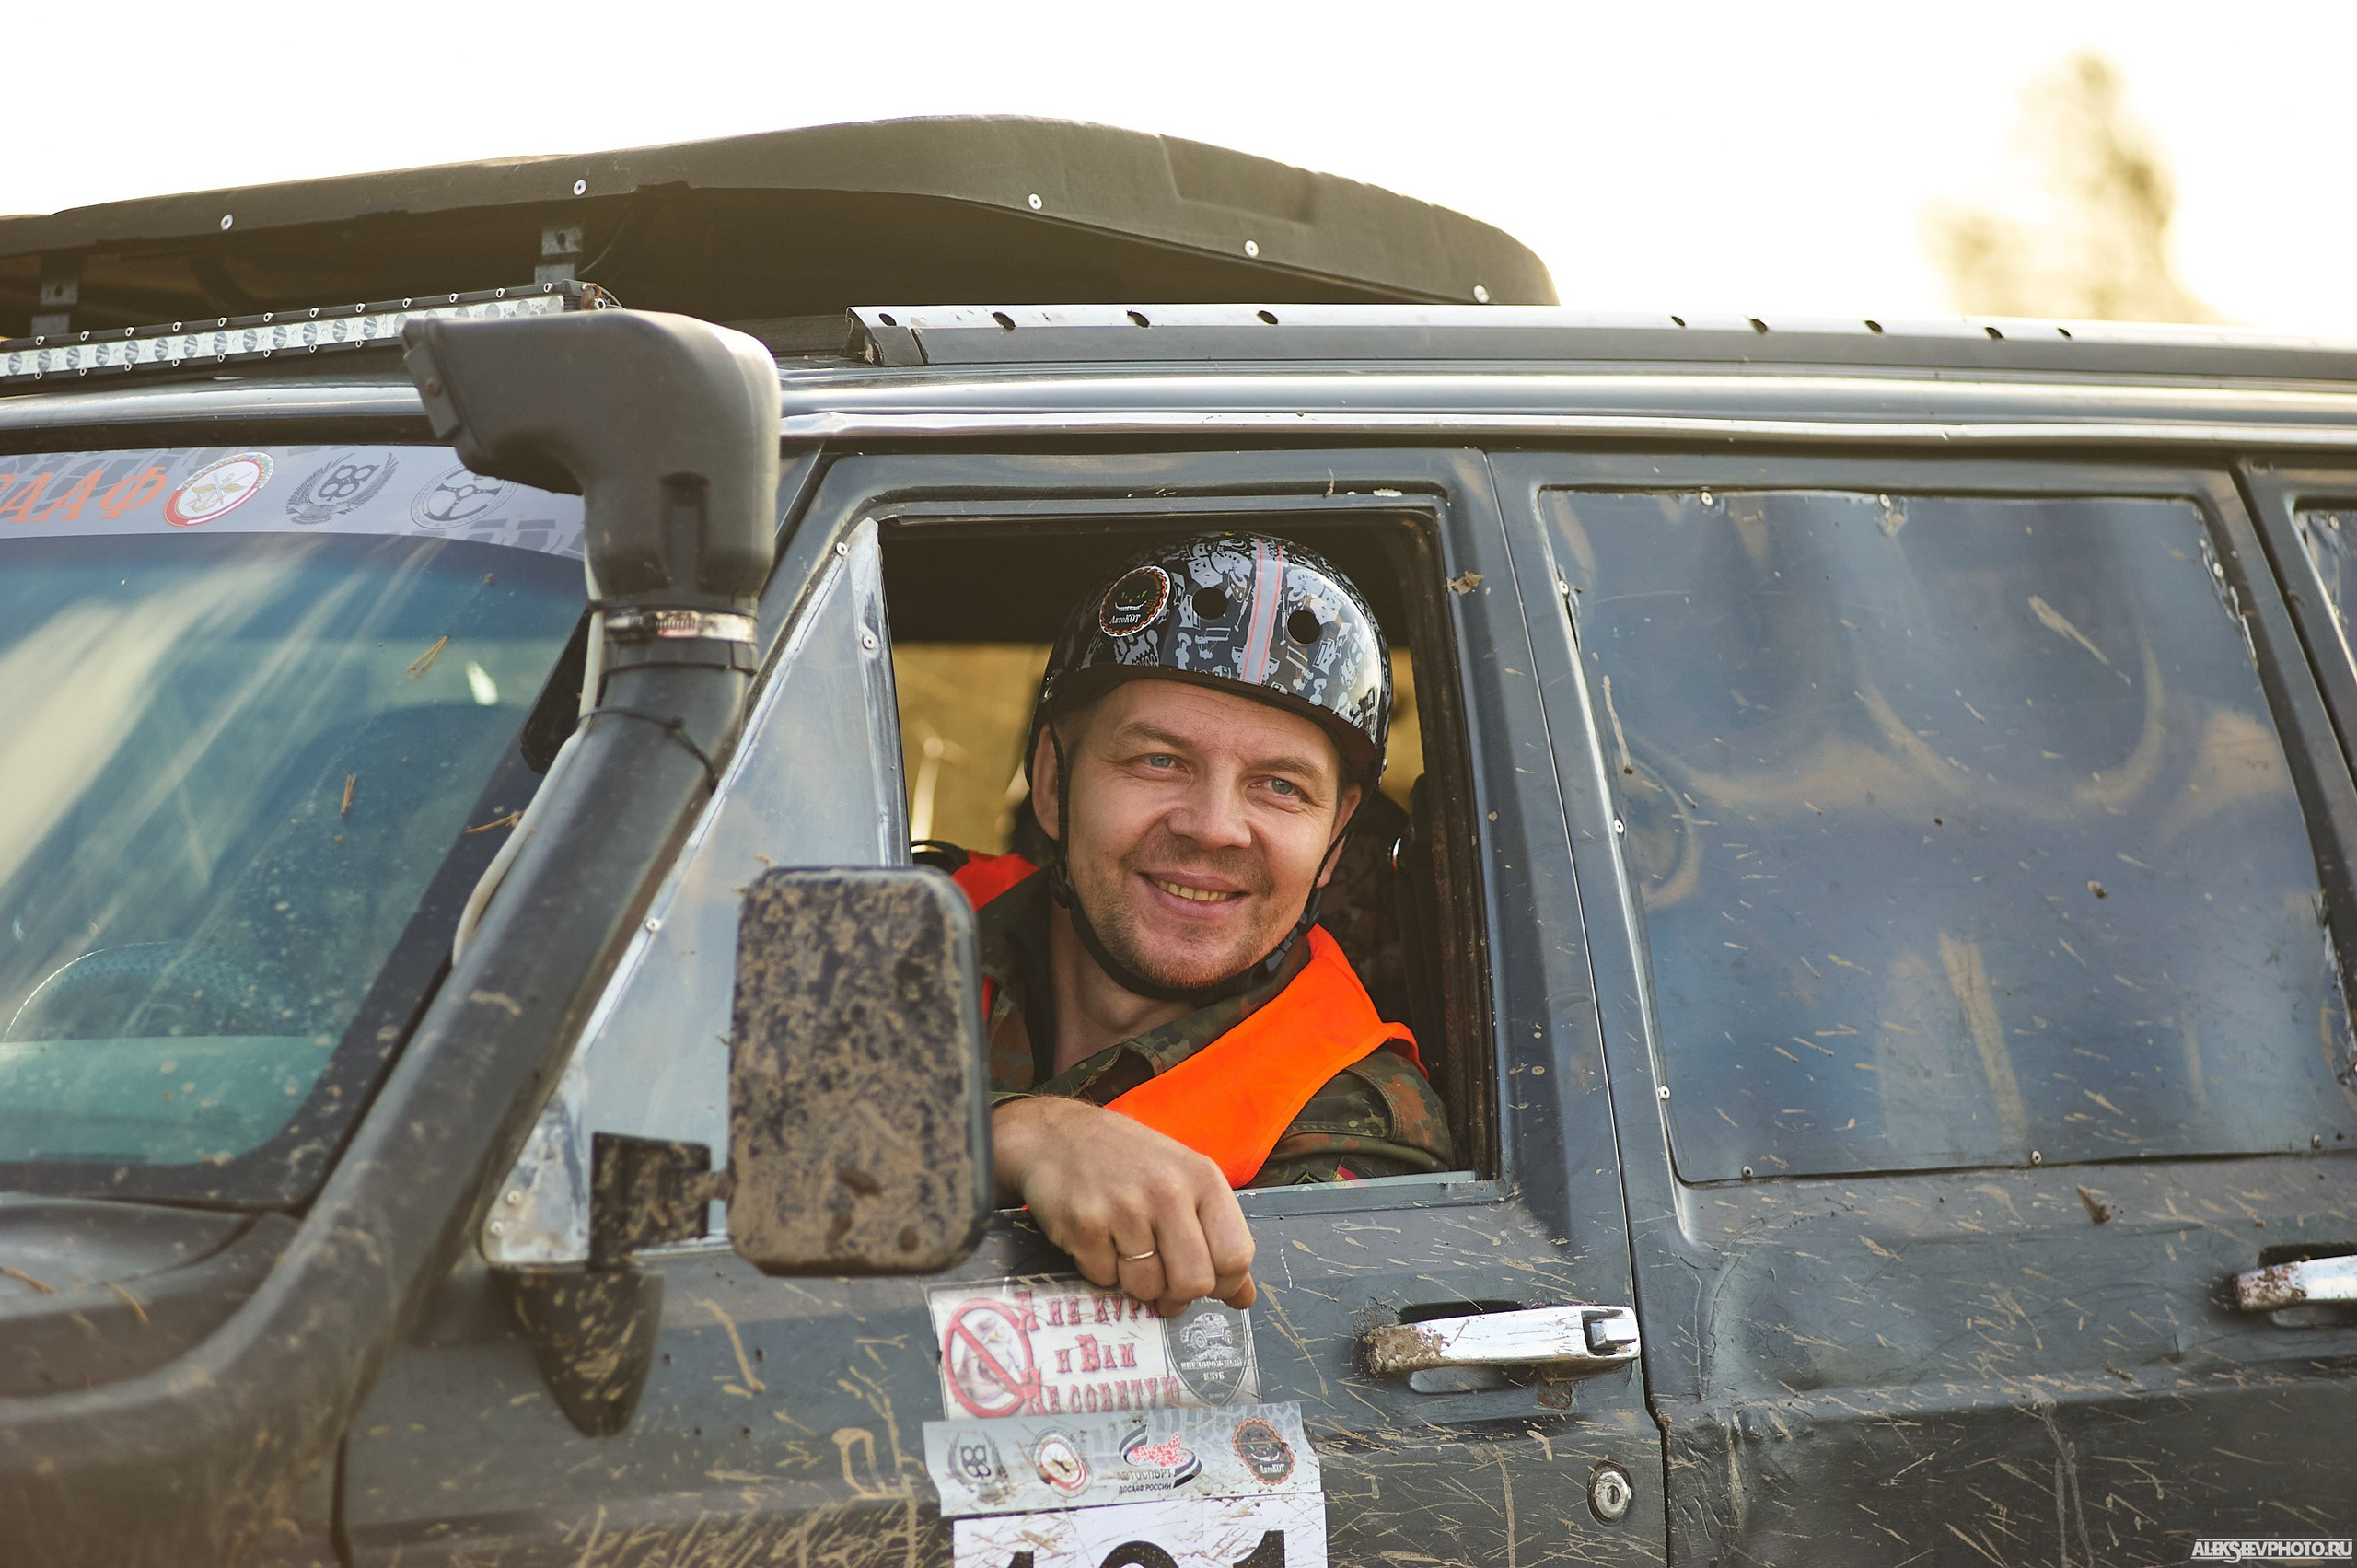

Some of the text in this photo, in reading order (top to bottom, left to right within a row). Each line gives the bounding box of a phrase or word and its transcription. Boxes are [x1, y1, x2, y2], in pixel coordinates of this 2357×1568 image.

[1014, 1290, 1039, 1331] Я
[1046, 1296, 1081, 1326] НЕ
[1119, 1483, 1172, 1494] ДОСААФ РОССИИ
